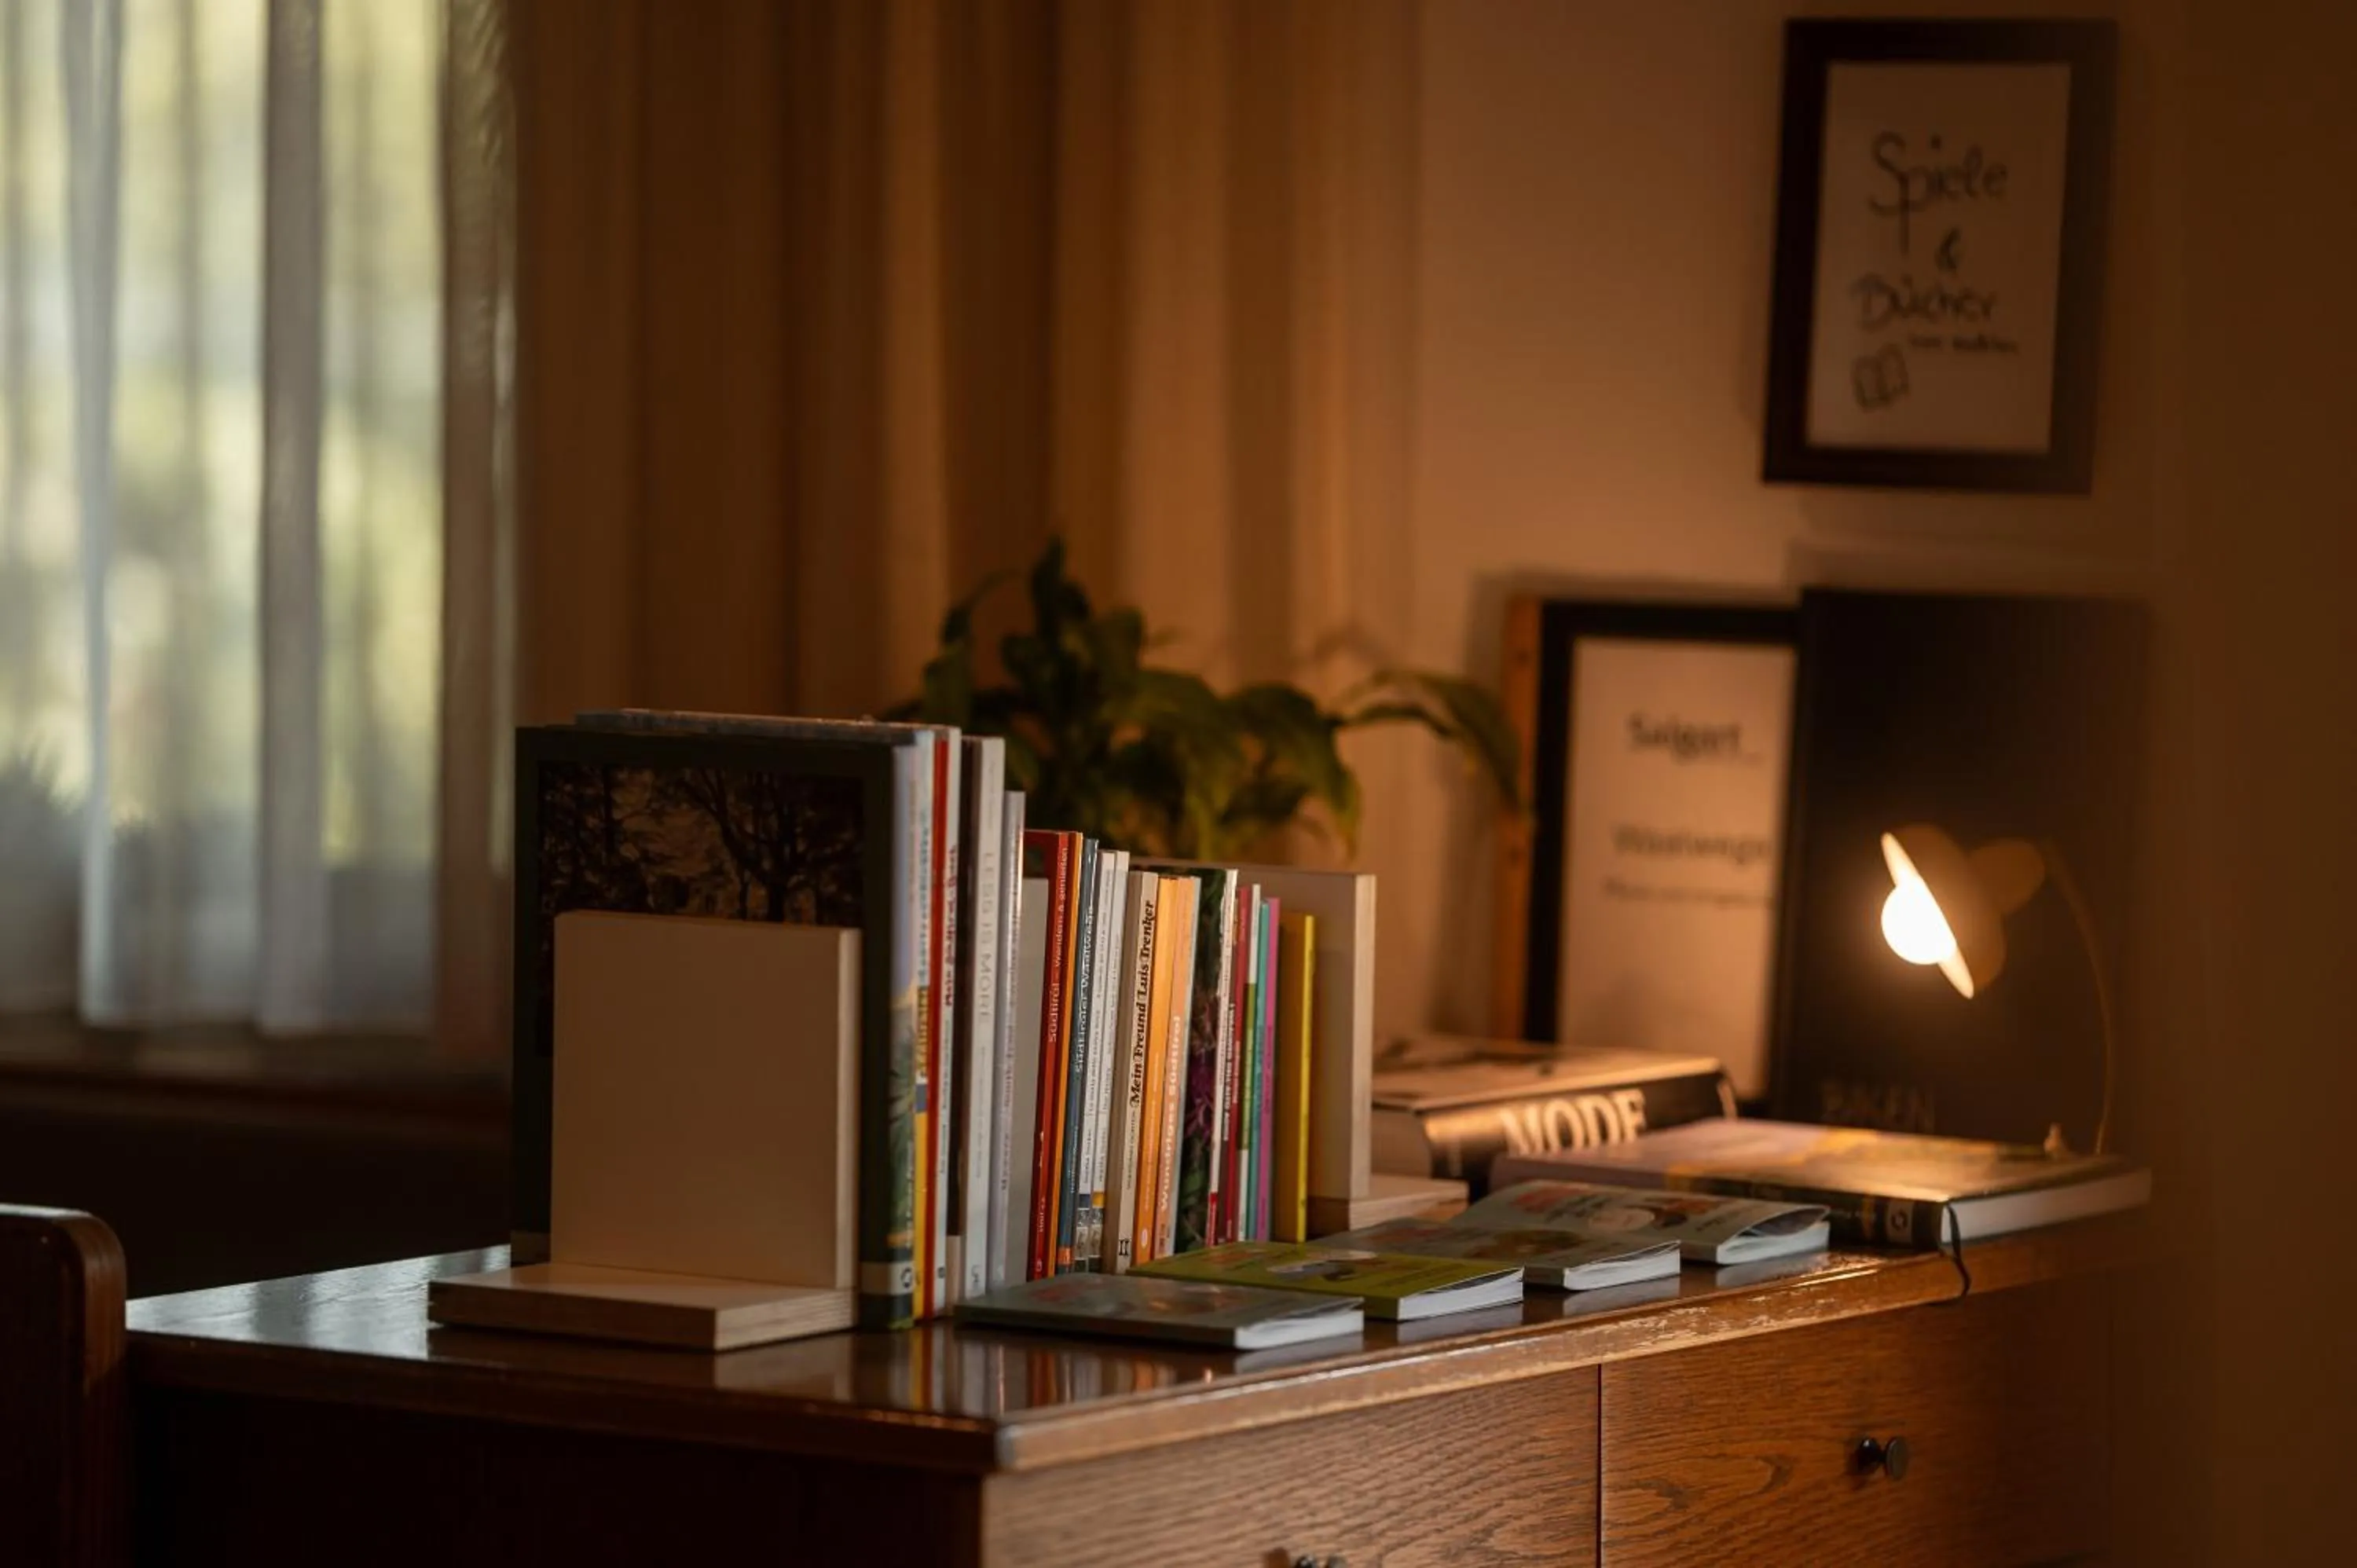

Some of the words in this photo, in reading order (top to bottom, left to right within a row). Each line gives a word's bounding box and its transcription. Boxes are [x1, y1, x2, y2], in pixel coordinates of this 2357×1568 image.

[1867, 130, 2009, 256] Spiele
[1140, 900, 1157, 962] Trenker
[1048, 982, 1060, 1043] Südtirol
[1137, 963, 1150, 1001] Luis
[1133, 1002, 1148, 1059] Freund
[1168, 1015, 1180, 1097] Südtirol
[1130, 1062, 1144, 1108] Mein
[1500, 1088, 1648, 1157] MODE
